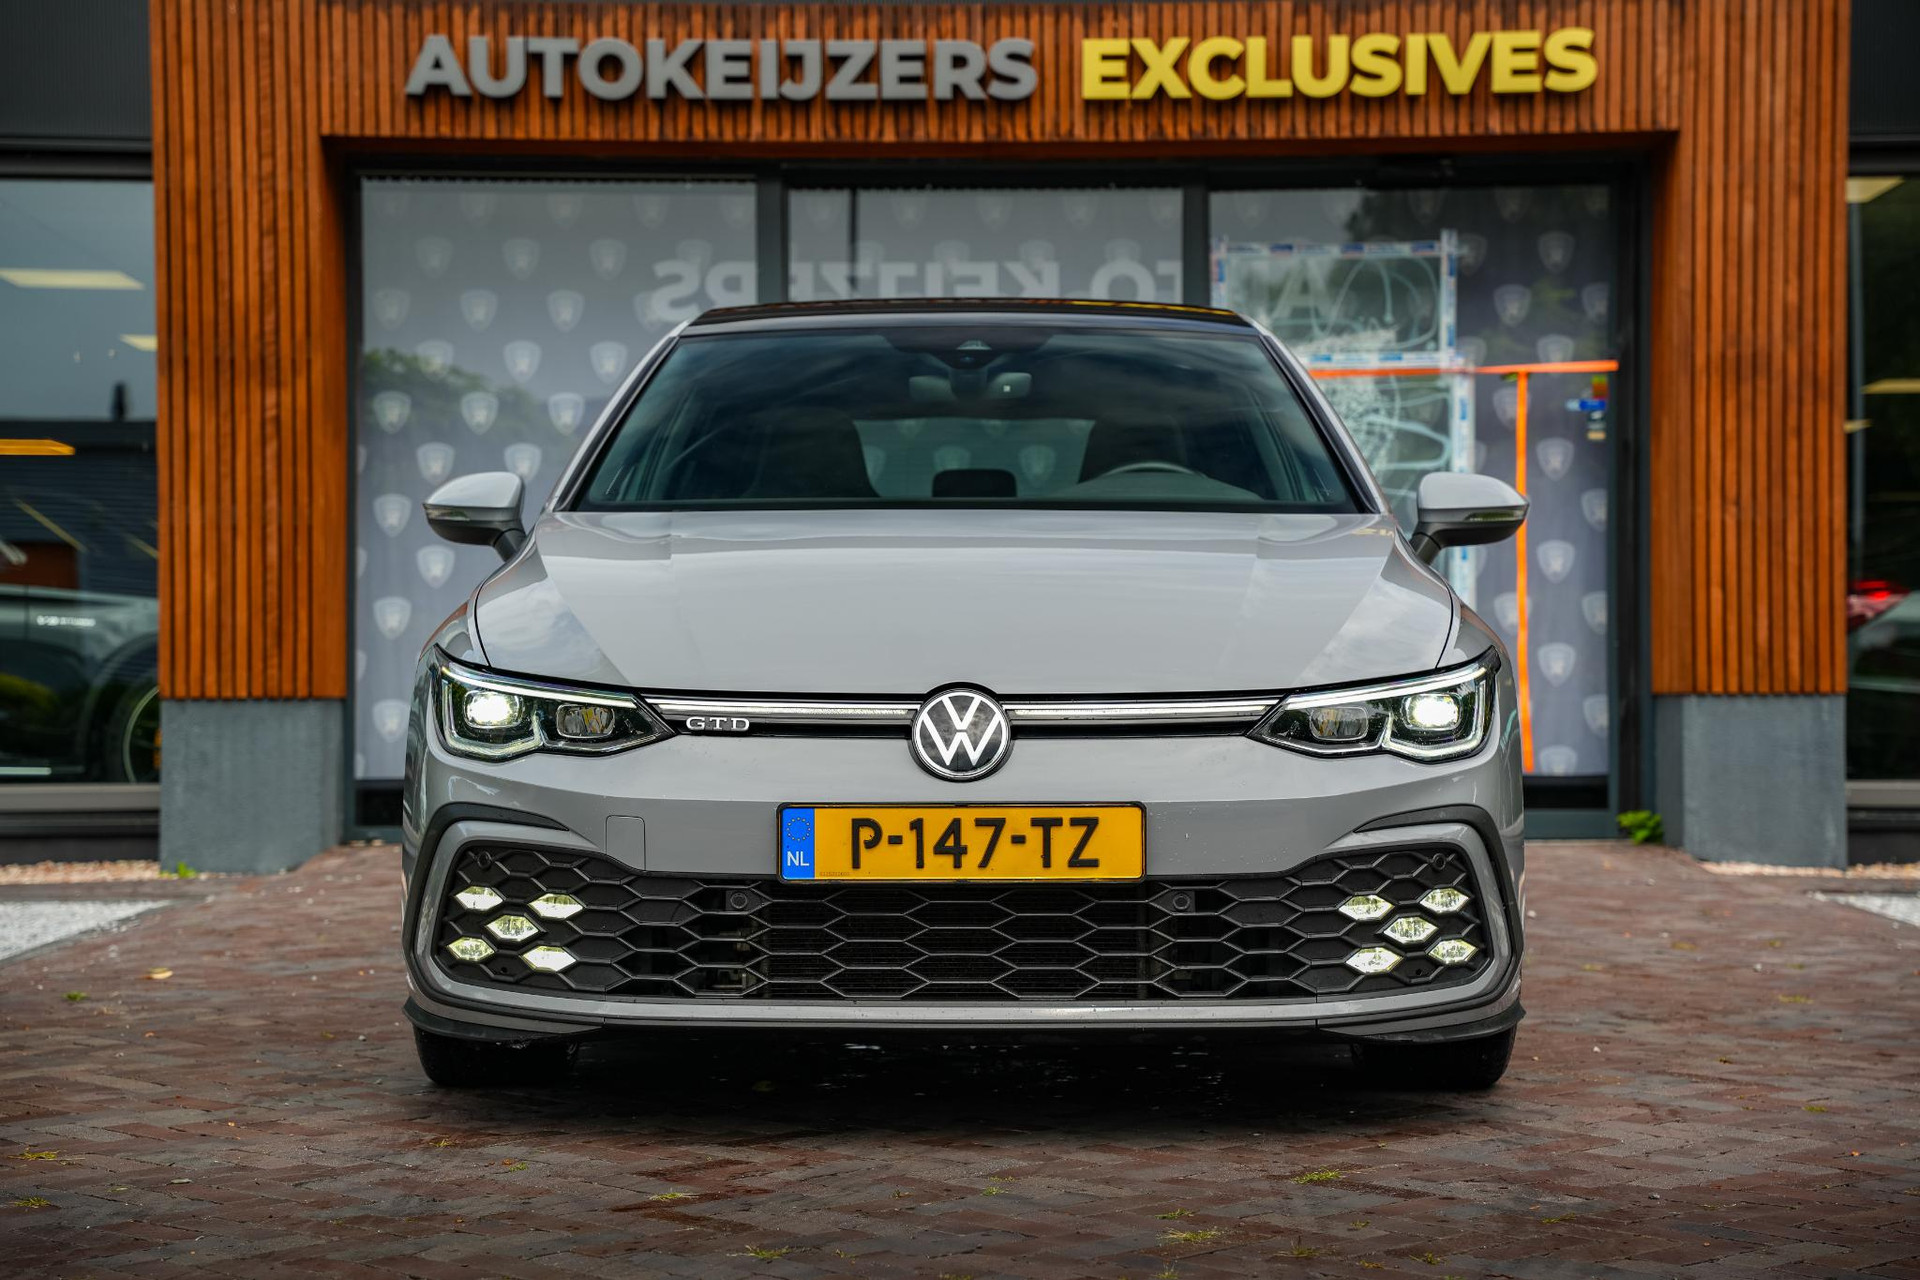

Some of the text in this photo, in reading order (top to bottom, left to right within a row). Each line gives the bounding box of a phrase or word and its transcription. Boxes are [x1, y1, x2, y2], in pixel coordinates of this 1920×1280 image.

[405, 28, 1598, 100] AUTOKEIJZERS EXCLUSIVES
[686, 716, 750, 731] GTD
[920, 696, 1003, 767] VW
[787, 850, 810, 866] NL
[851, 817, 1101, 869] P-147-TZ
